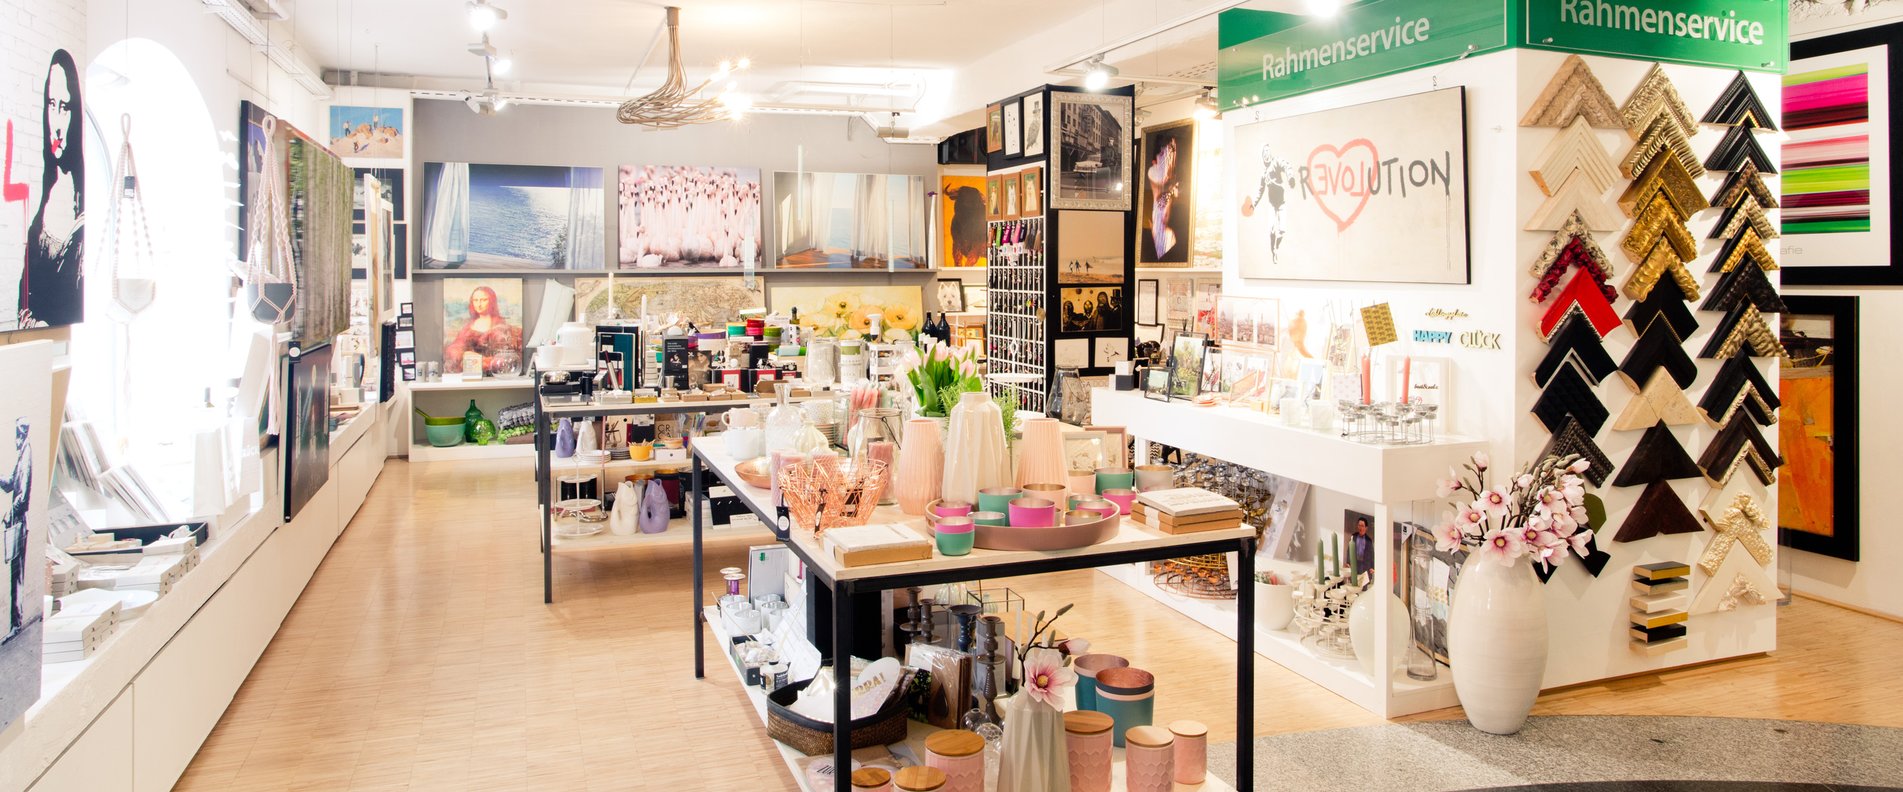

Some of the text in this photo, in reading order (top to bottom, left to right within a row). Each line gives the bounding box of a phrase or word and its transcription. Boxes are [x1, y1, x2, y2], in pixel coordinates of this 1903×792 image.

[1560, 0, 1764, 45] Rahmenservice
[1262, 16, 1430, 81] Rahmenservice
[1413, 329, 1452, 344] HAPPY
